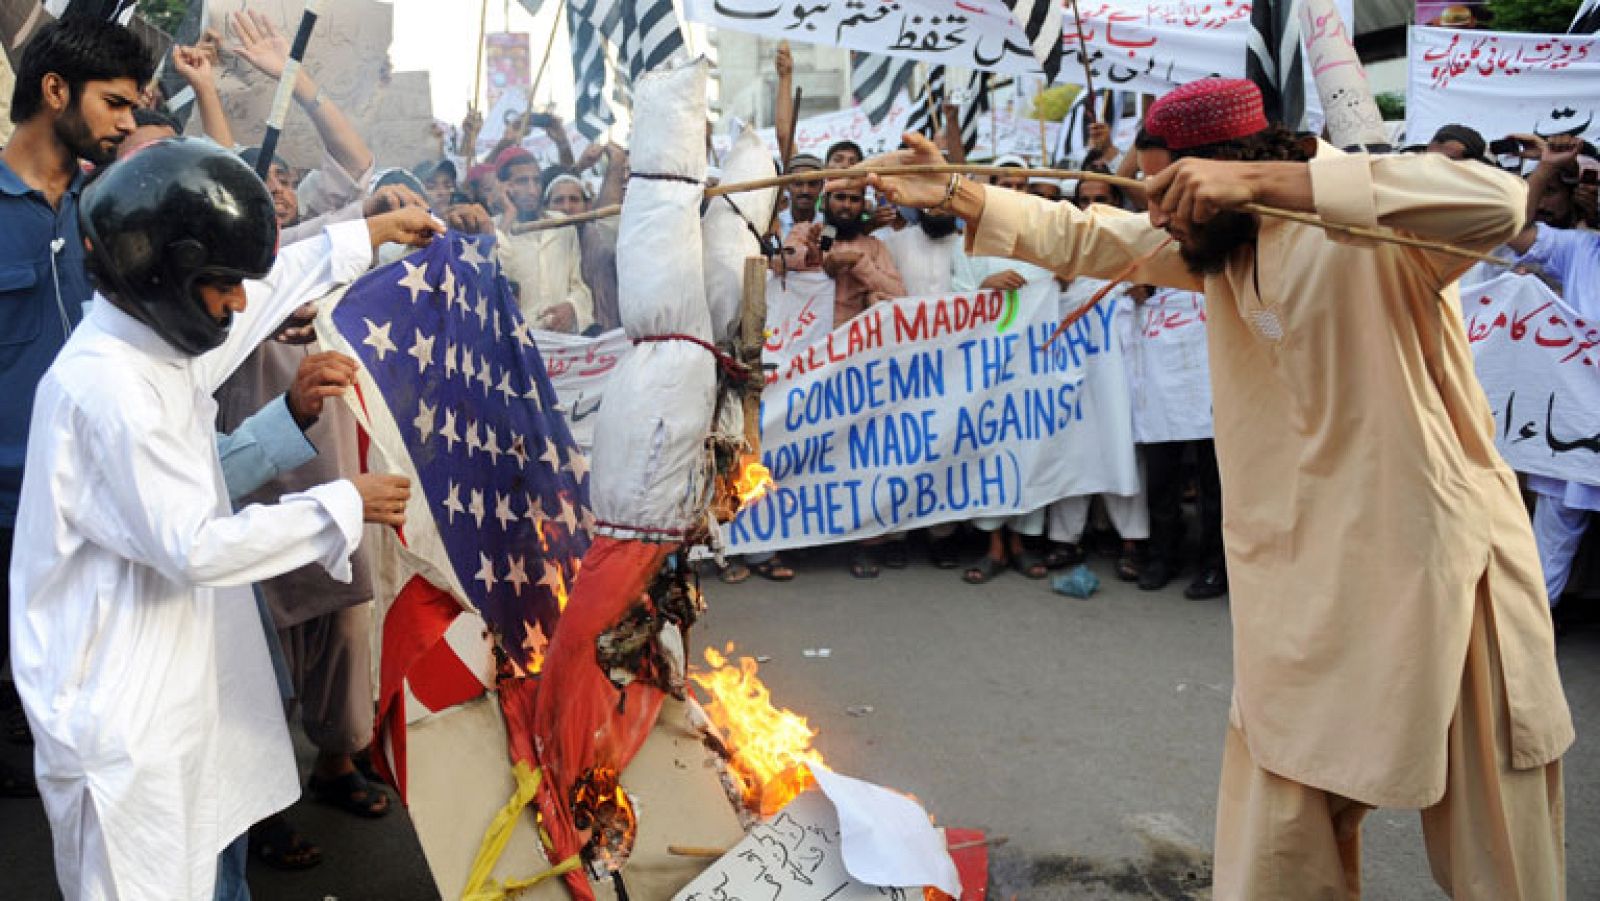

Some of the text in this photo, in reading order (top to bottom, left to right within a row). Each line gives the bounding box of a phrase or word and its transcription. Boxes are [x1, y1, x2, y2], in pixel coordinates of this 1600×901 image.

[887, 13, 968, 51] تحفظ
[786, 309, 883, 380] ALLAH
[1510, 301, 1556, 341] کا
[785, 349, 945, 432] CONDEMN
[957, 332, 1020, 394] THE
[849, 410, 940, 470] MADE
[953, 380, 1085, 452] AGAINST
